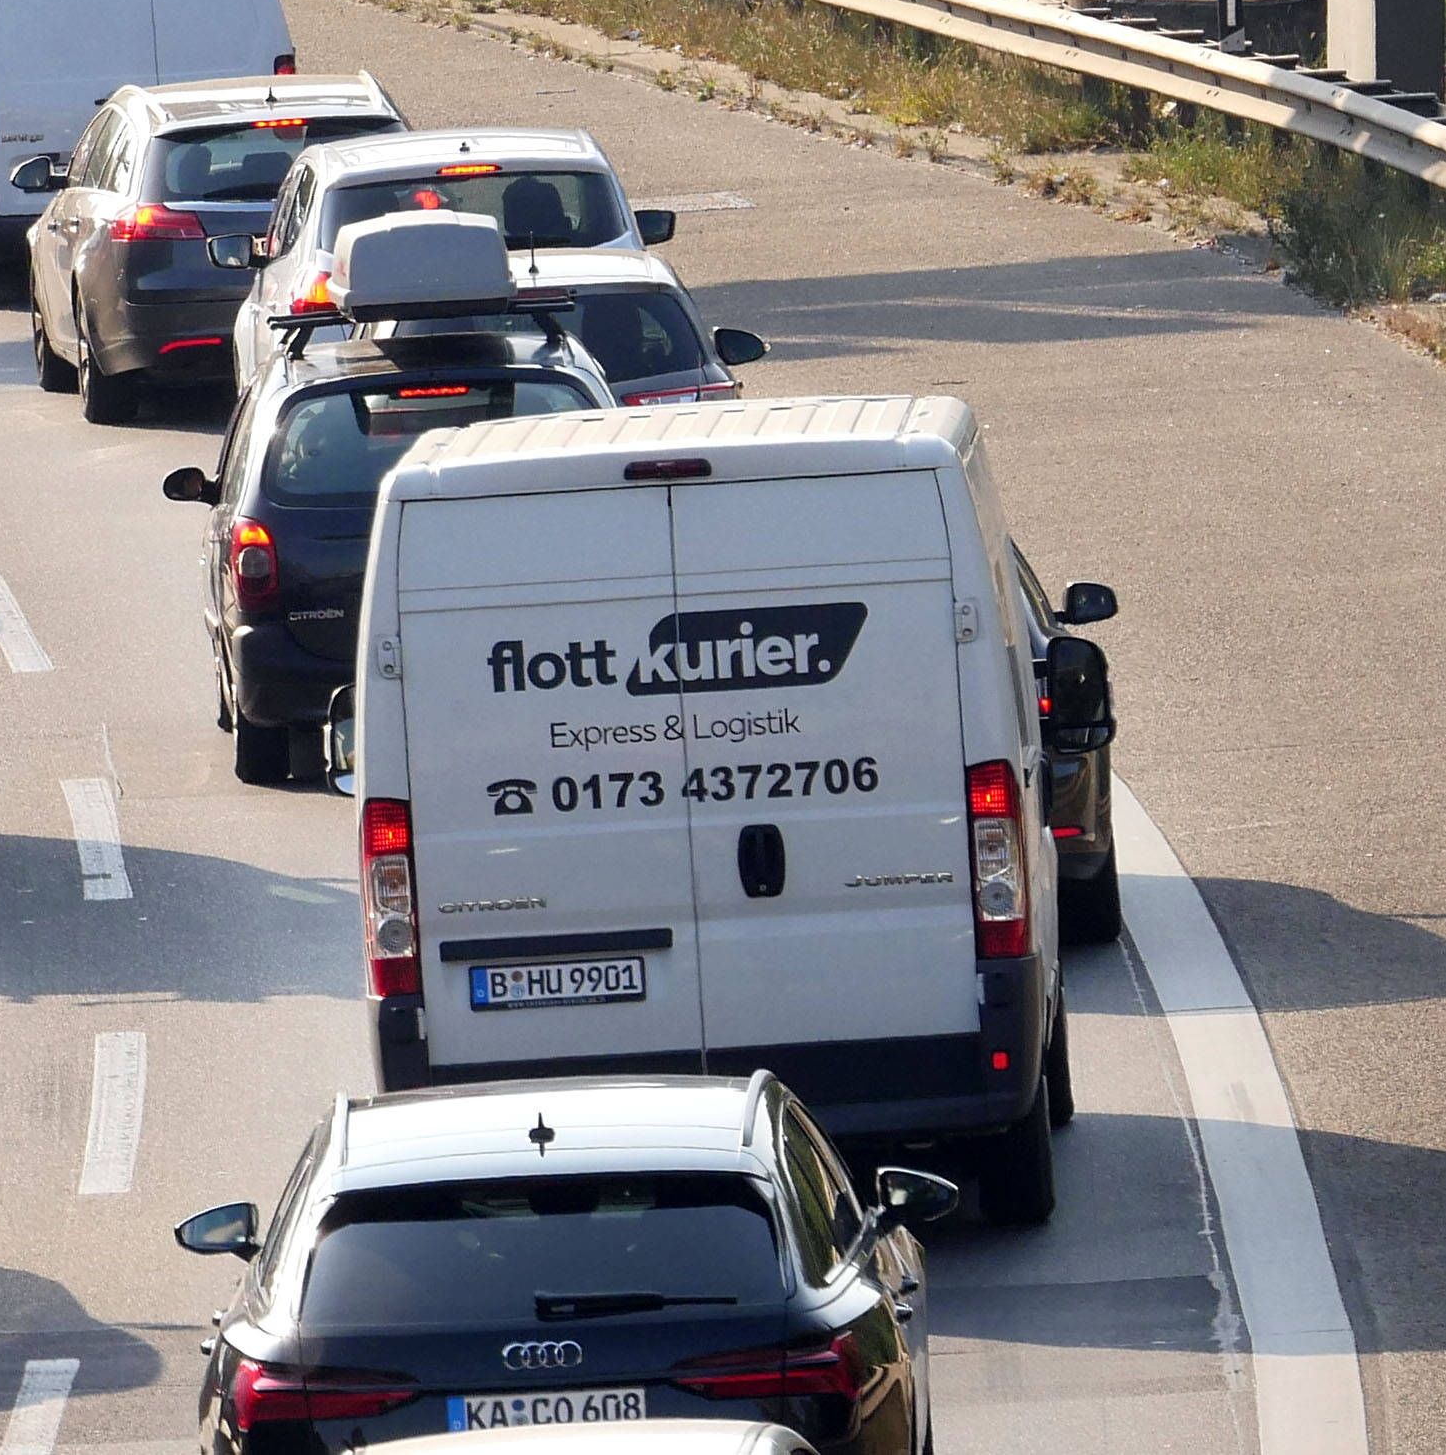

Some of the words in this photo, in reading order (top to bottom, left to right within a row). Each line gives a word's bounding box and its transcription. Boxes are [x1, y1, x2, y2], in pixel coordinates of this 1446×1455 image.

[487, 640, 617, 693] flott
[550, 719, 657, 752] Express
[664, 714, 685, 740] &
[693, 708, 802, 743] Logistik
[551, 770, 665, 812] 0173
[681, 756, 879, 803] 4372706
[844, 872, 954, 888] JUMPER
[437, 896, 547, 914] CITROËN
[490, 972, 508, 997] B
[528, 968, 563, 996] HU
[569, 965, 638, 994] 9901
[466, 1401, 509, 1430] KA
[532, 1396, 574, 1425] CO
[582, 1392, 641, 1422] 608
